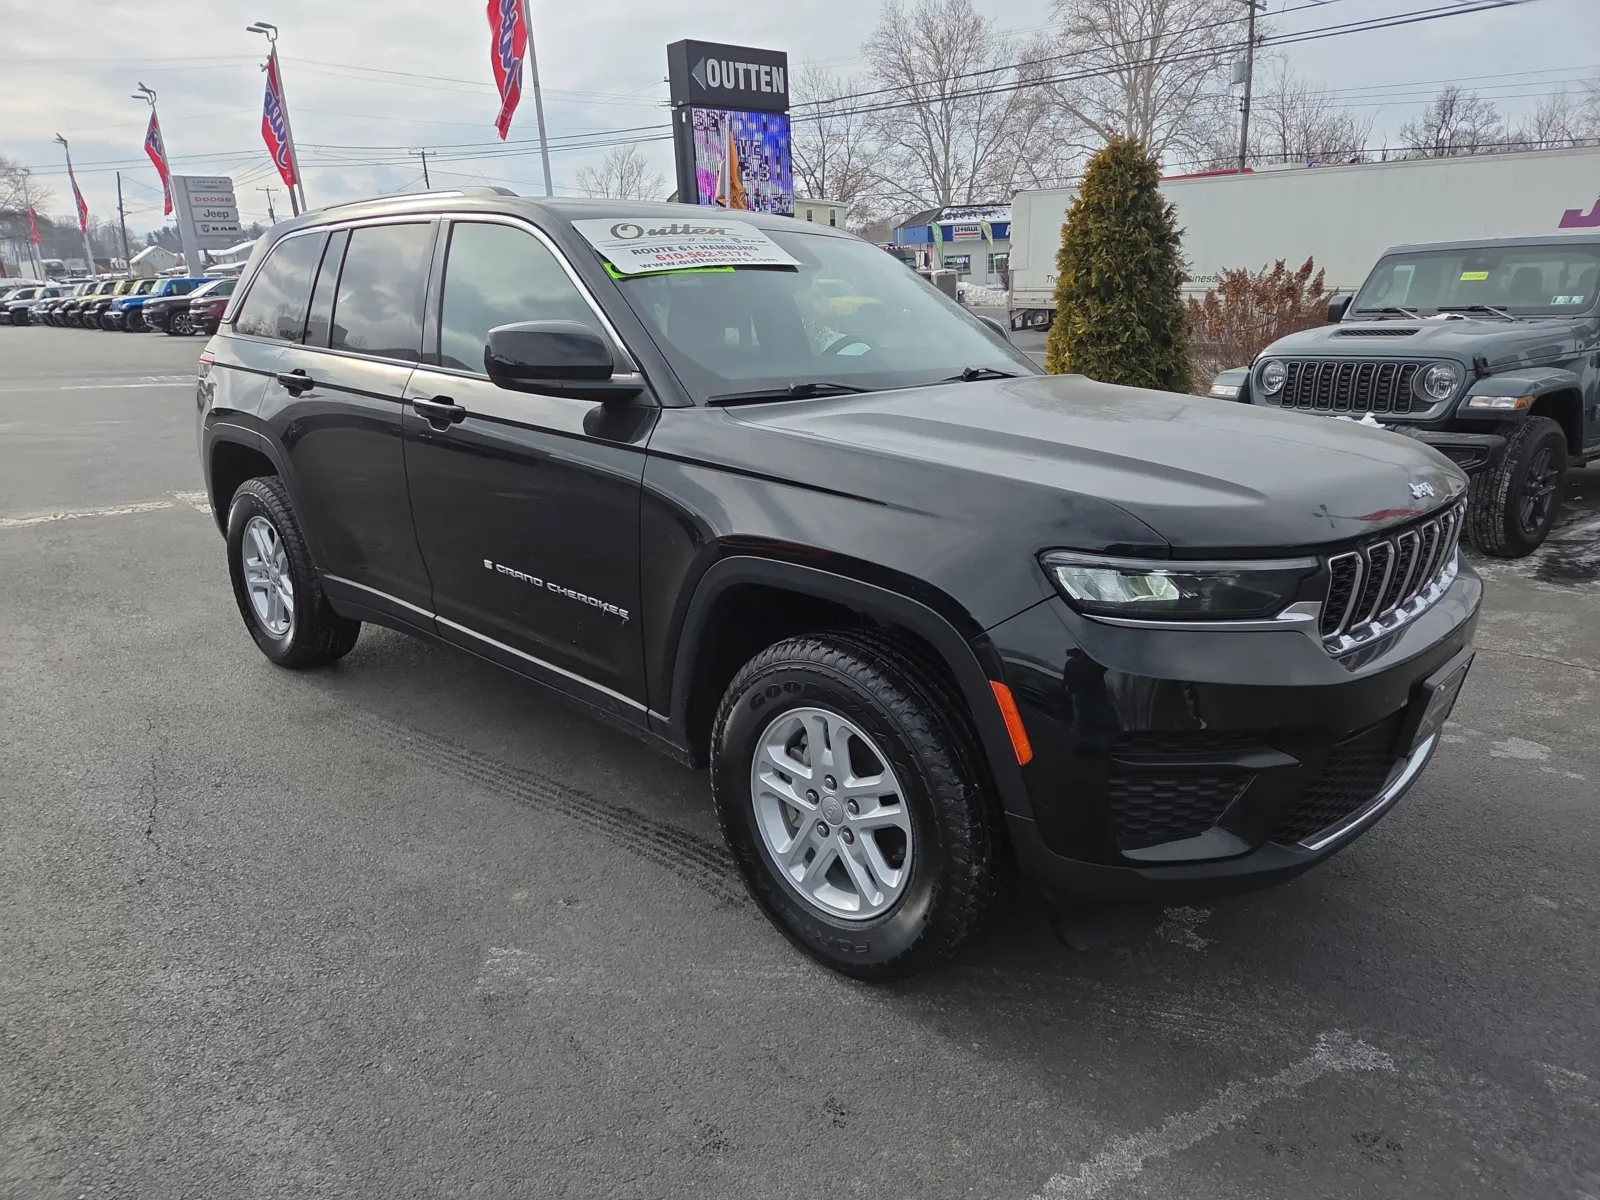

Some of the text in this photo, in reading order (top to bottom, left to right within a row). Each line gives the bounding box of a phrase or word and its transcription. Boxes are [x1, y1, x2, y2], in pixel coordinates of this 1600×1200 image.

[706, 58, 785, 94] OUTTEN
[203, 209, 229, 219] Jeep
[610, 222, 735, 240] Outten
[631, 245, 675, 255] ROUTE
[655, 250, 752, 261] 610-562-5174
[639, 256, 779, 268] www.outtencars.com
[1409, 481, 1435, 498] Jeep
[495, 563, 629, 619] GRAND CHEROKEE
